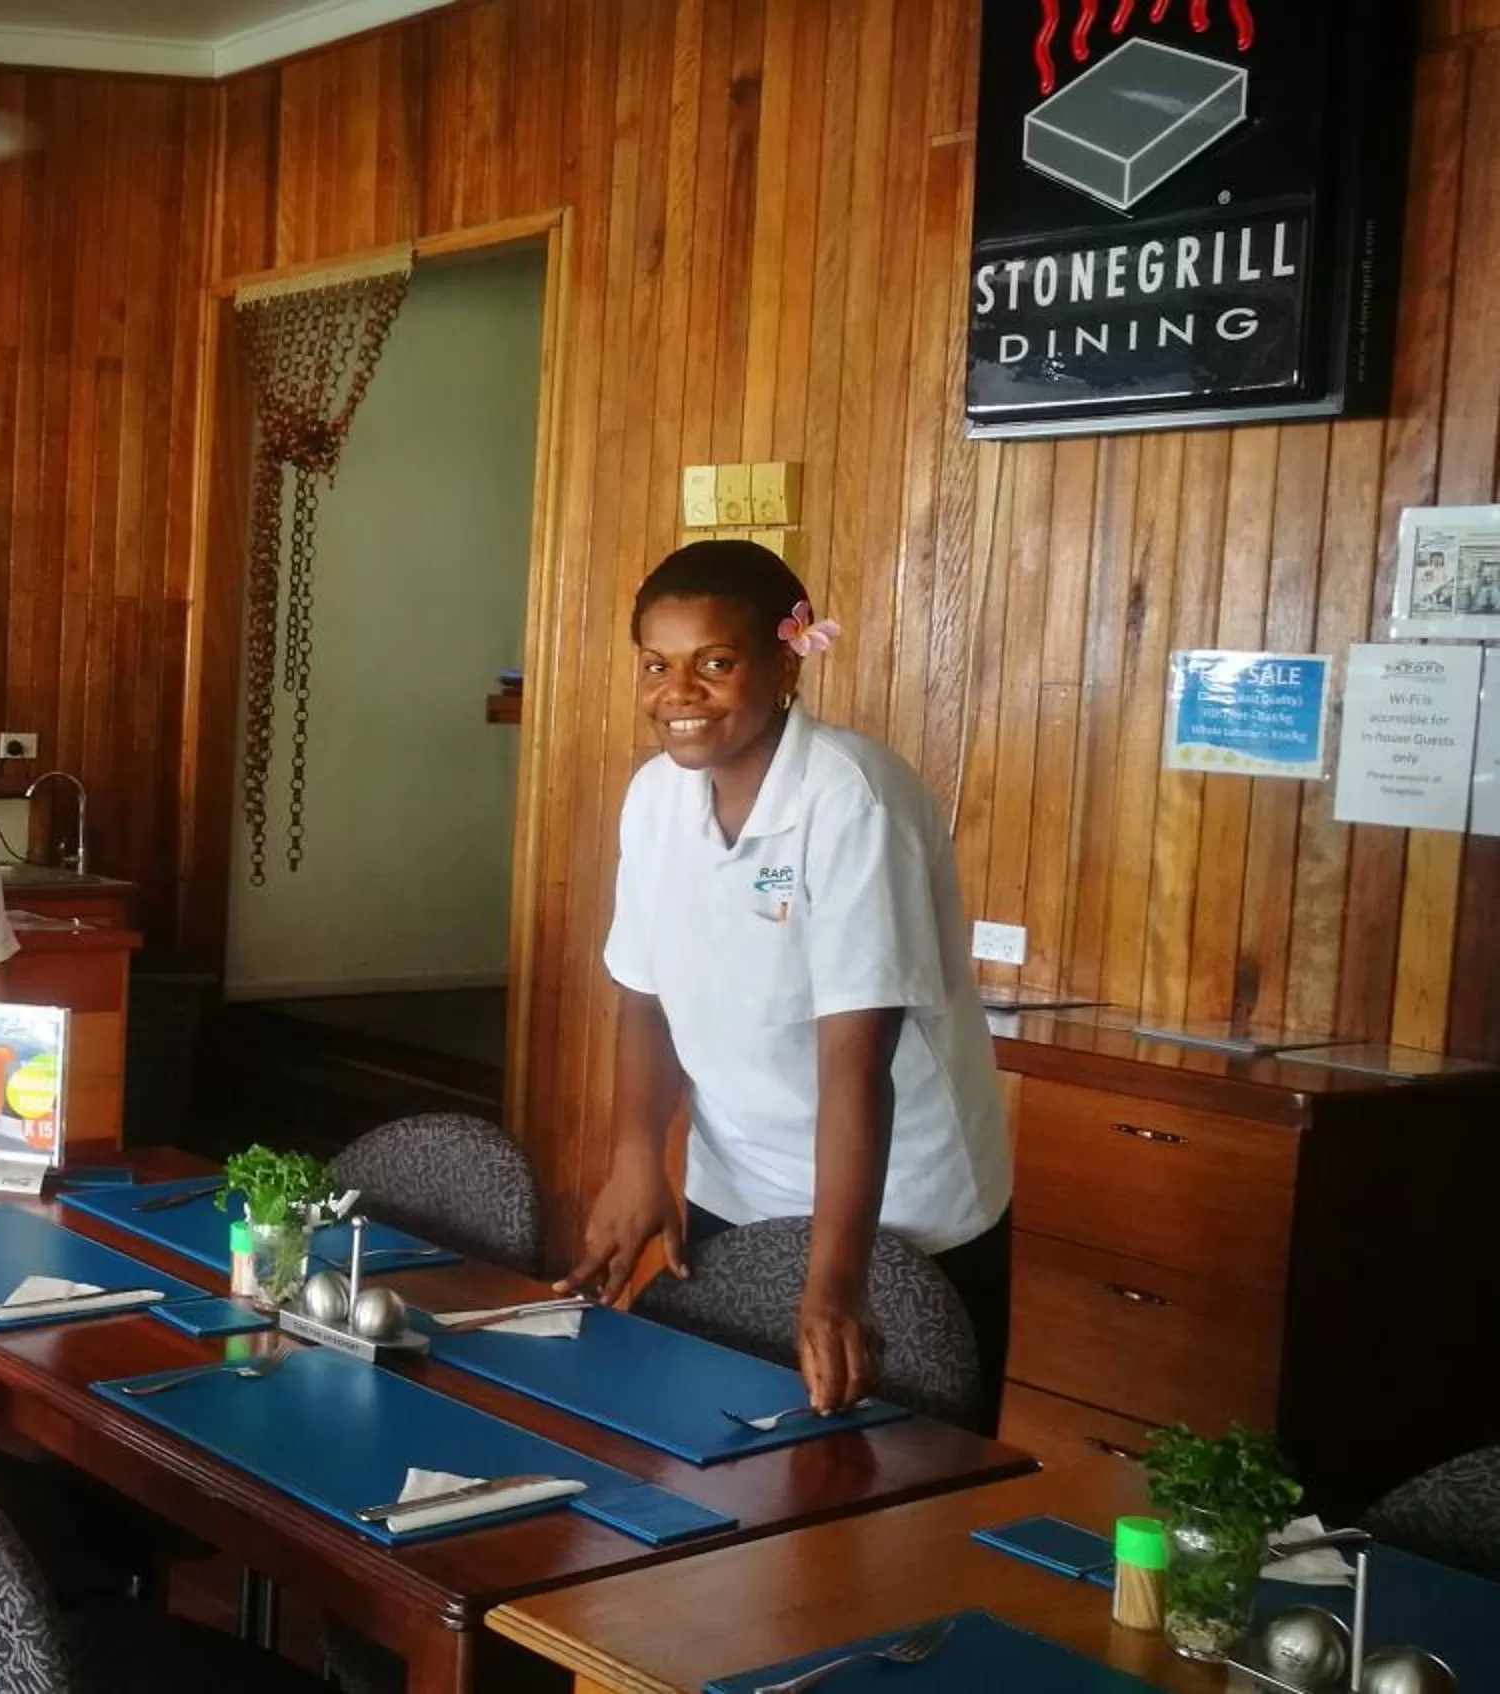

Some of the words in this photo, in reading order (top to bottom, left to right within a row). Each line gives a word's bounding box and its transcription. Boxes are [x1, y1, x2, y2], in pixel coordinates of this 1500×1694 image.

[976, 222, 1295, 314] STONEGRILL
[1000, 307, 1259, 363] DINING
[1247, 664, 1301, 685] SALE
[1392, 752, 1419, 765] only
